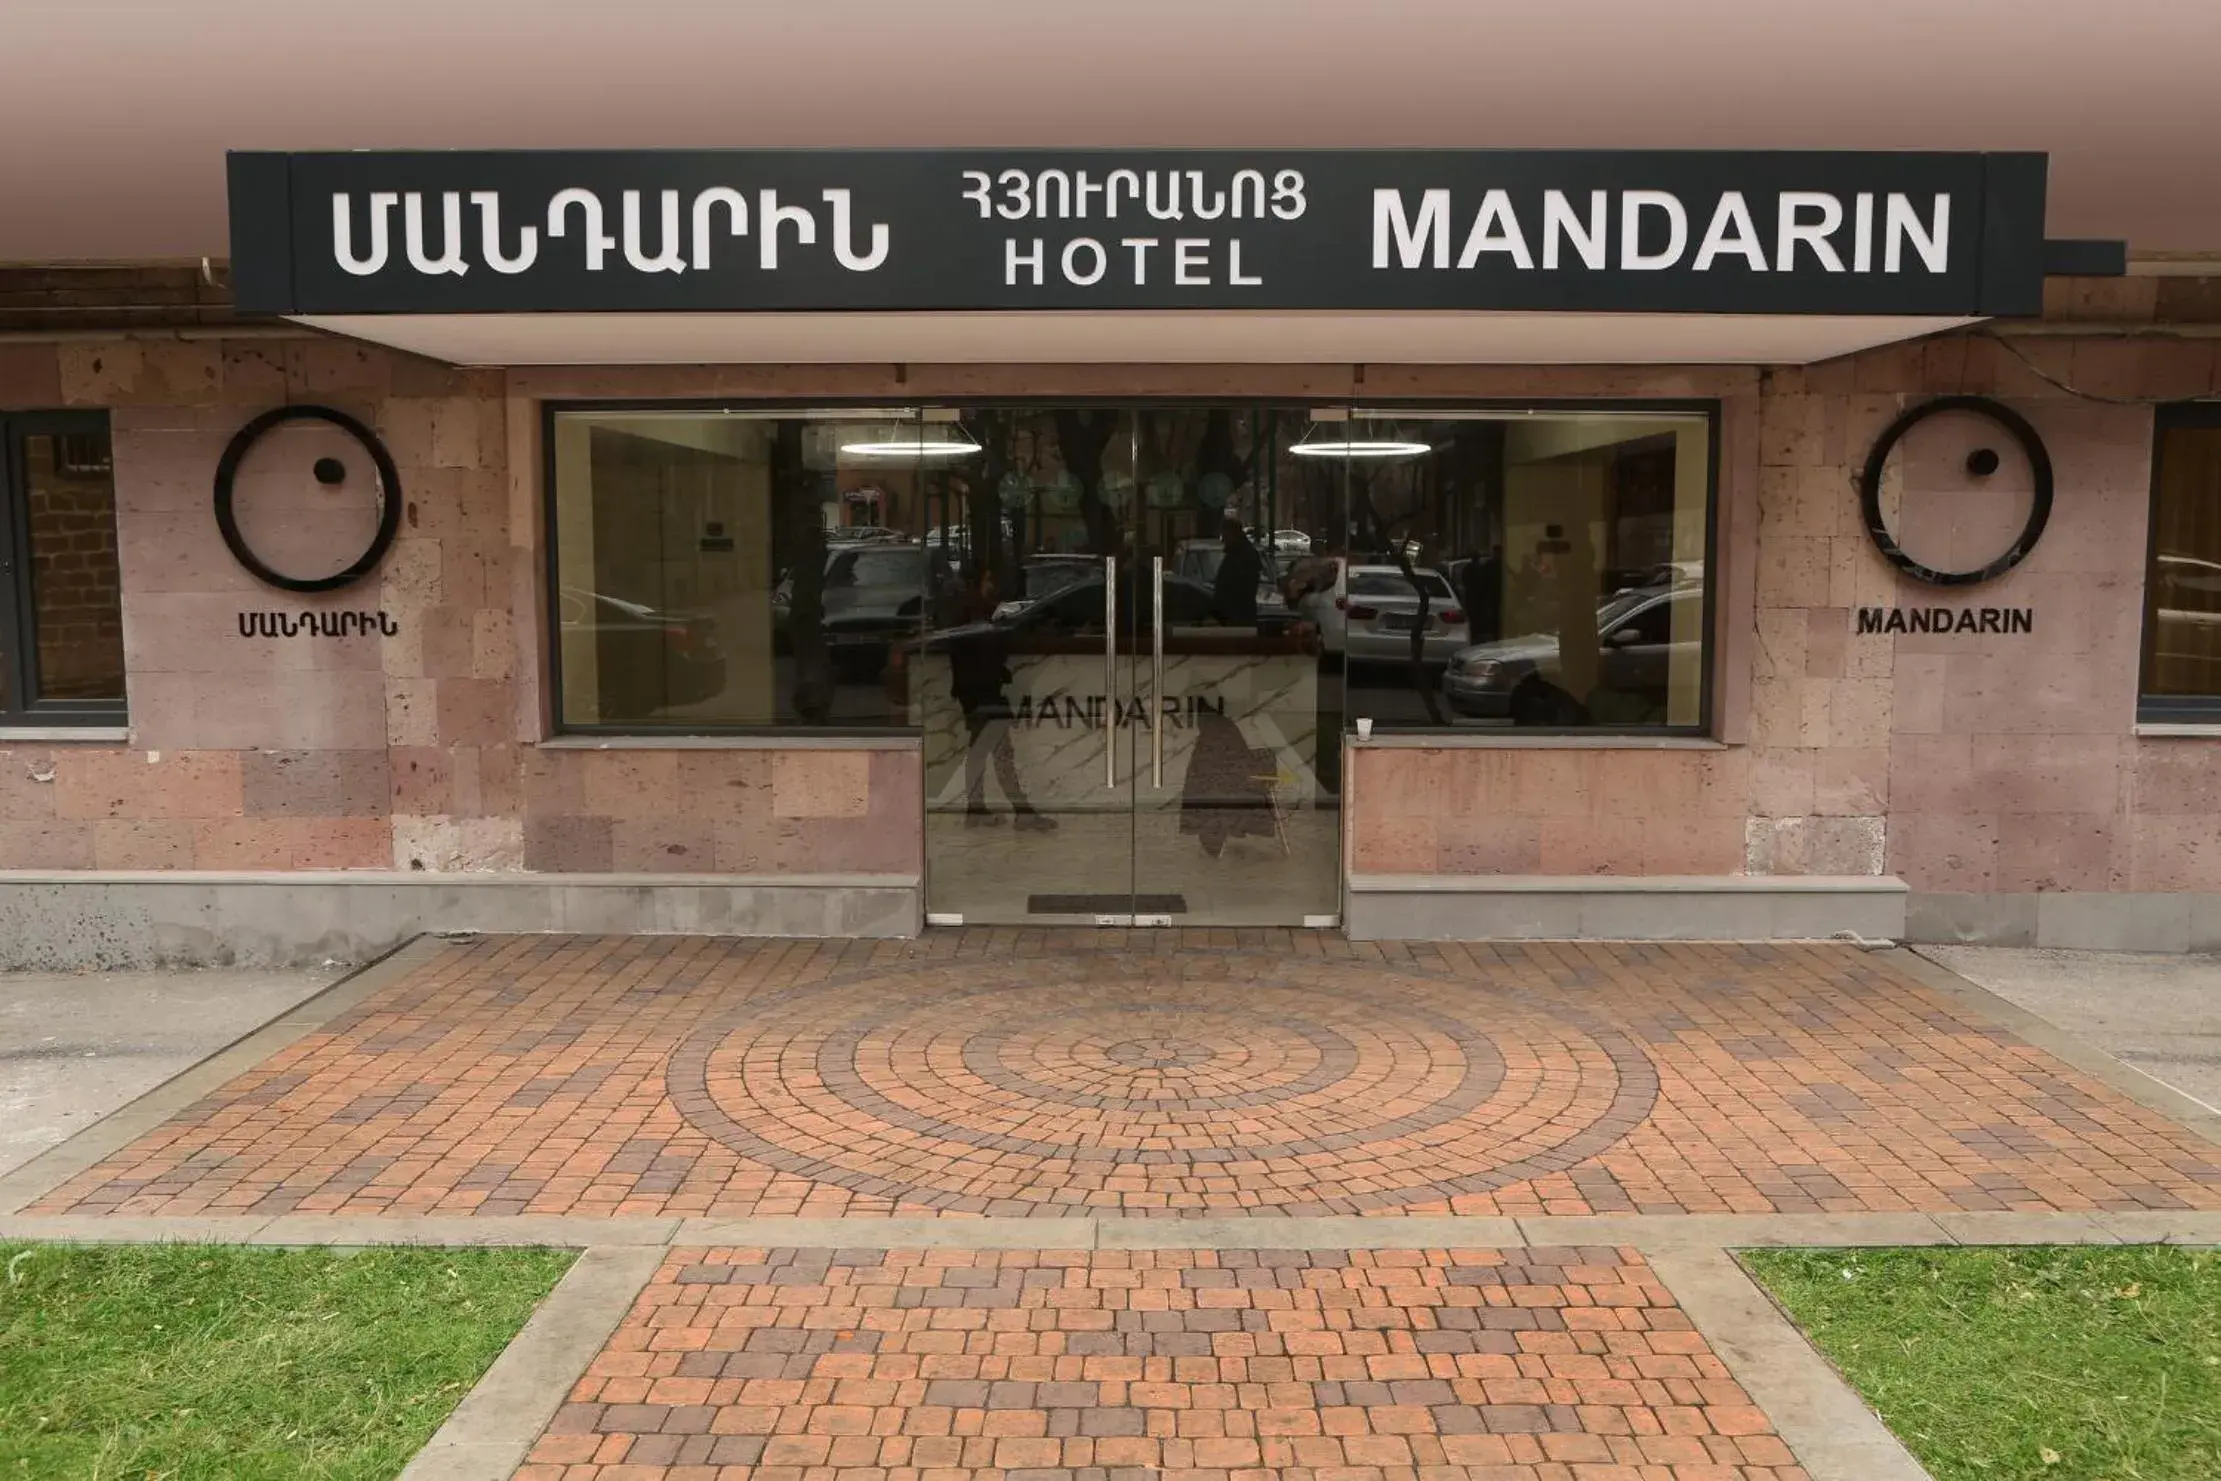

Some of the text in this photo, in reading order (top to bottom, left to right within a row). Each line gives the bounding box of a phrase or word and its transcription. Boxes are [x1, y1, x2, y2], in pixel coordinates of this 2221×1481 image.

[962, 168, 1307, 221] ՀՅՈՒՐԱՆՈՑ
[332, 186, 890, 277] ՄԱՆԴԱՐԻՆ
[1372, 188, 1951, 273] MANDARIN
[1005, 237, 1263, 286] HOTEL
[238, 610, 399, 638] ՄԱՆԴԱՐԻՆ
[1856, 607, 2034, 636] MANDARIN
